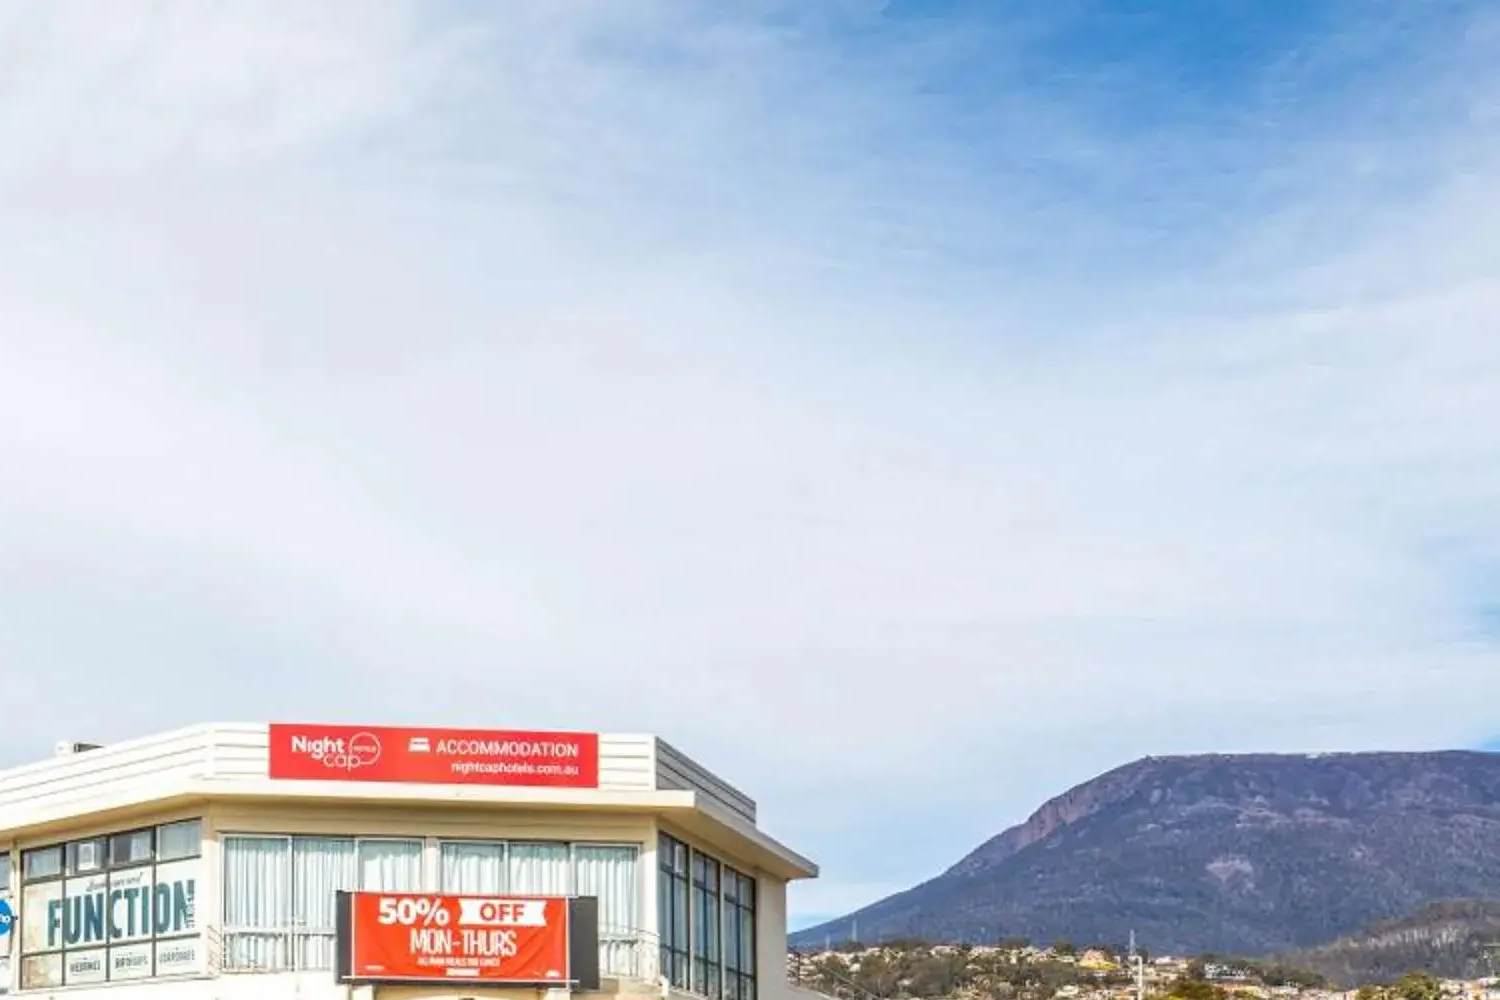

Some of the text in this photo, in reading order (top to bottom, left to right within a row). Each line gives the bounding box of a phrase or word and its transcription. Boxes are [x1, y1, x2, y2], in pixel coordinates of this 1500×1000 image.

[291, 735, 344, 759] Night
[436, 739, 579, 758] ACCOMMODATION
[323, 754, 362, 773] cap
[451, 760, 579, 776] nightcaphotels.com.au
[47, 880, 189, 947] FUNCTION
[377, 896, 526, 926] 50% OFF
[410, 927, 518, 957] MON-THURS
